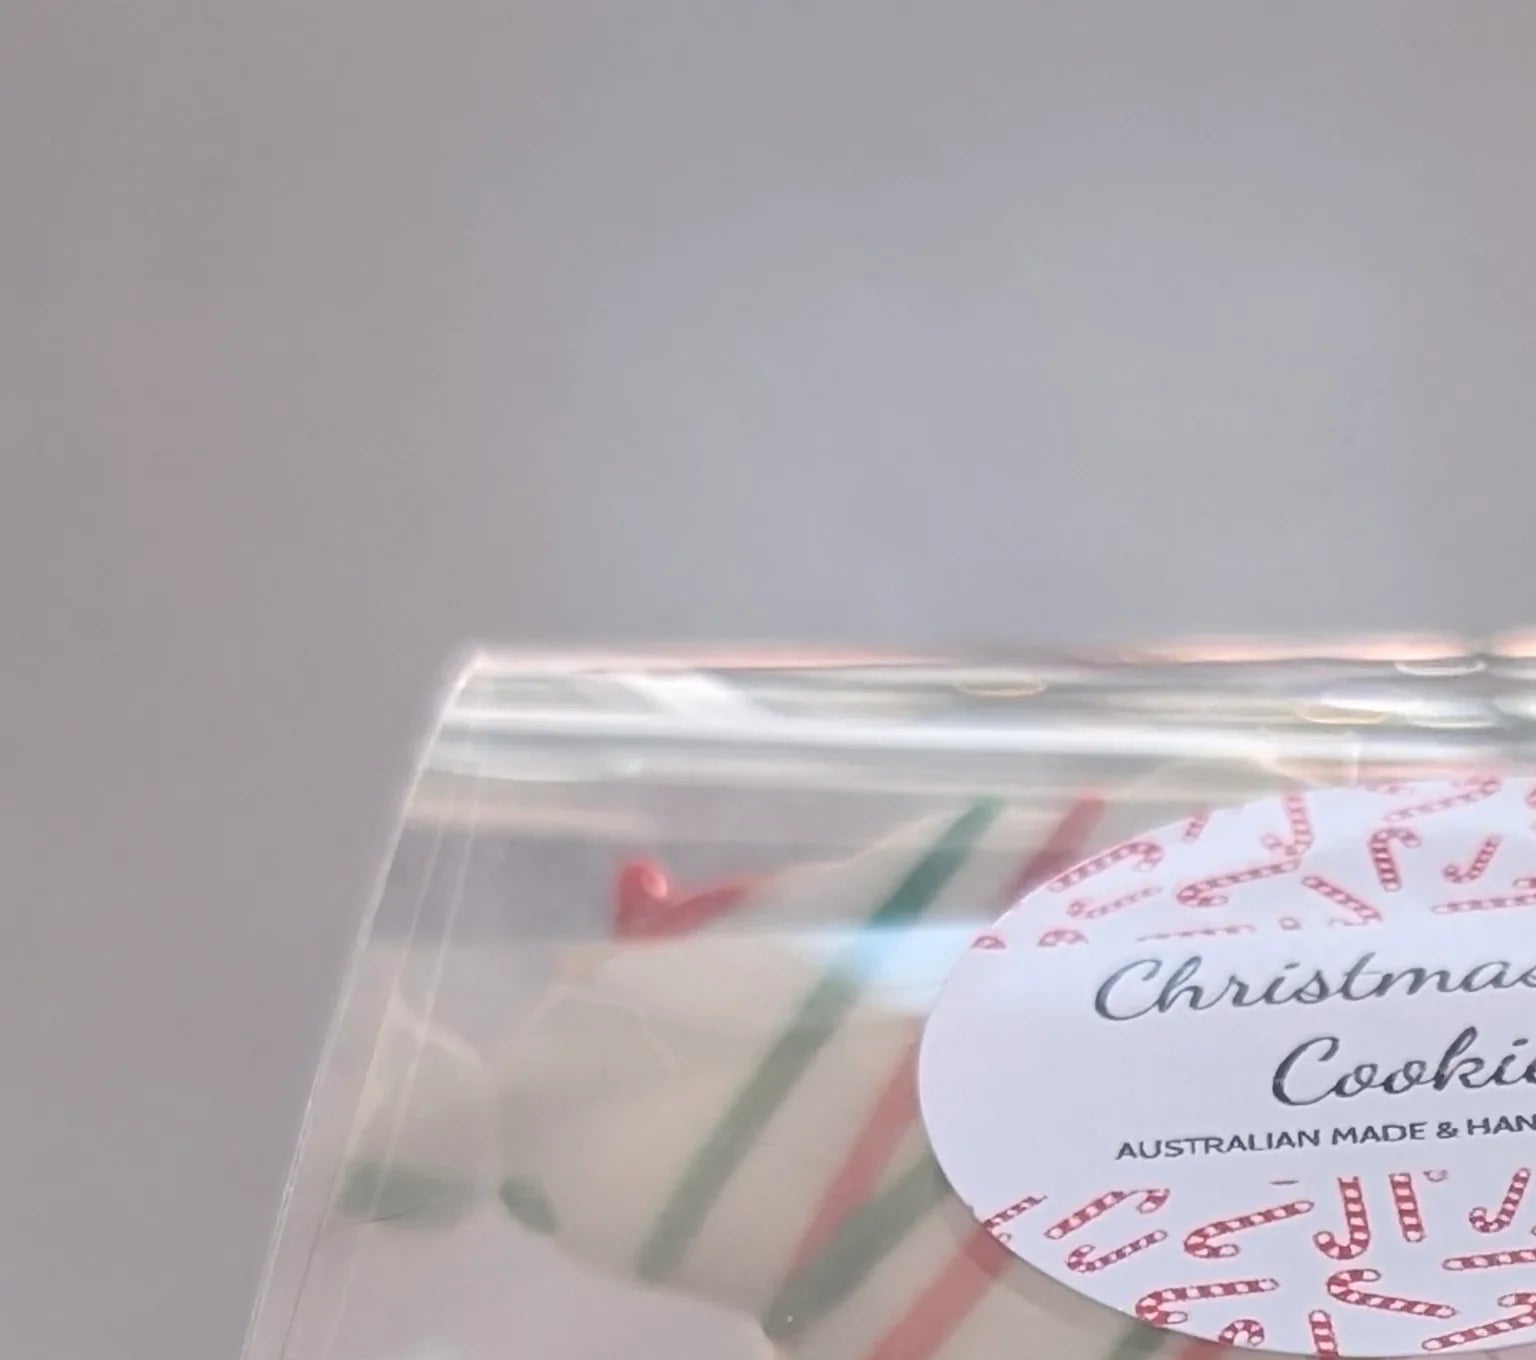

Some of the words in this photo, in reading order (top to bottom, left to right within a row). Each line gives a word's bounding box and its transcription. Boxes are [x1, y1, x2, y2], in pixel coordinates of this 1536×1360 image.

[1114, 1128, 1321, 1161] AUSTRALIAN
[1330, 1121, 1428, 1146] MADE
[1435, 1120, 1460, 1140] &
